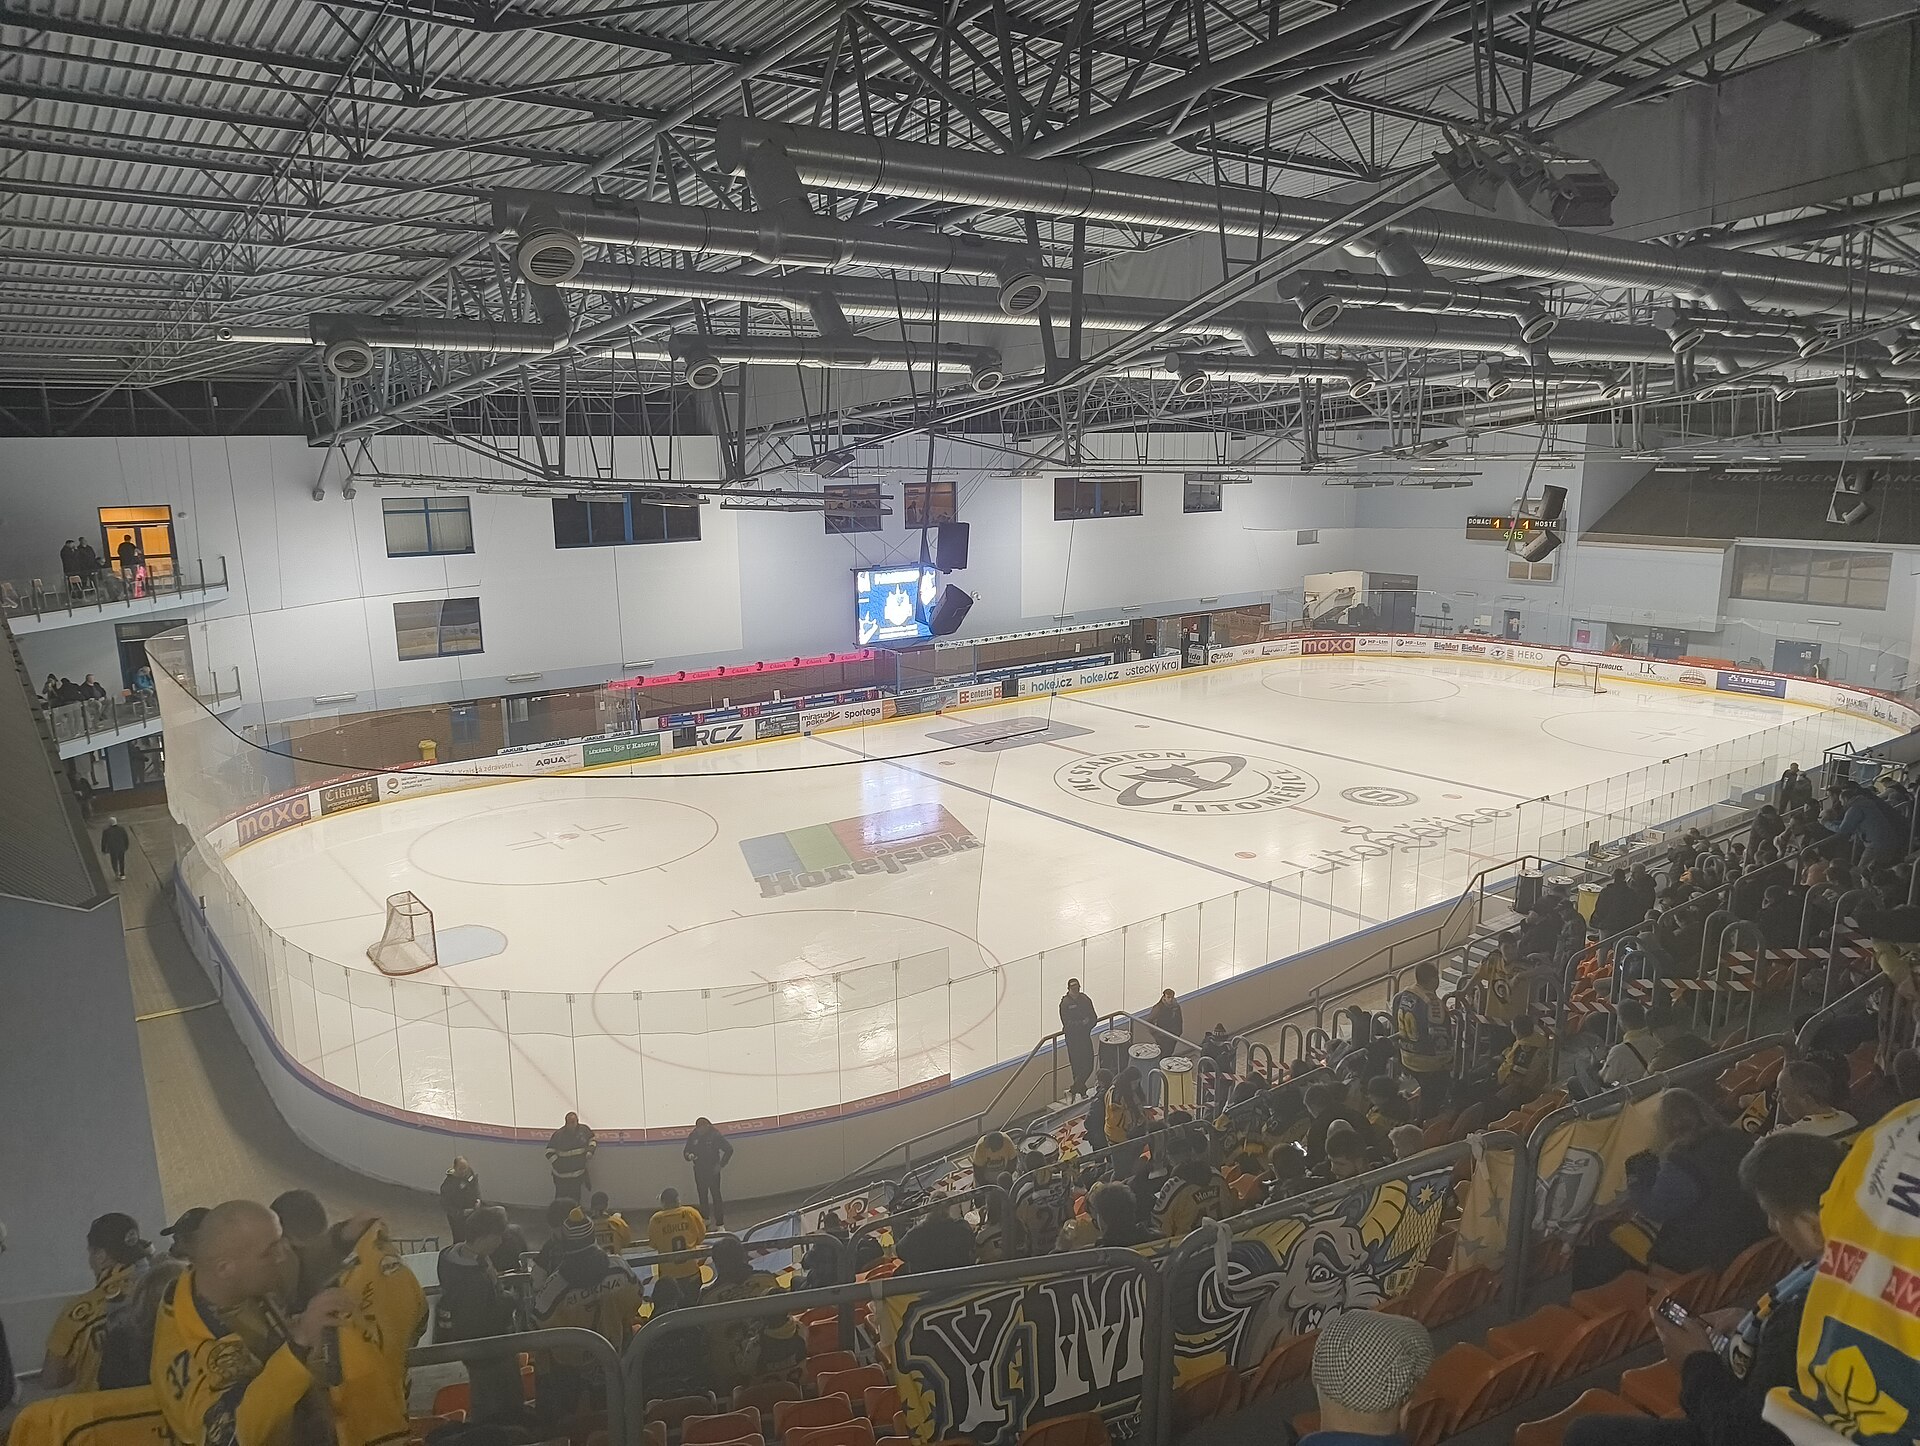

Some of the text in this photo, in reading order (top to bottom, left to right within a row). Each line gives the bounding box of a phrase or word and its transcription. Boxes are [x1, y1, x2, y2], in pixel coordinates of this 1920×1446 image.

[1493, 519, 1500, 529] 1
[1522, 520, 1529, 529] 1
[1302, 639, 1355, 652] maxa
[1517, 650, 1543, 661] HERO
[1161, 659, 1180, 672] kraj
[1640, 662, 1657, 675] LK
[1079, 670, 1119, 685] hokej.cz
[1739, 676, 1776, 687] TREMIS
[1031, 677, 1072, 693] hokej.cz
[970, 687, 993, 699] enteria
[801, 709, 835, 722] mirasushi
[844, 706, 881, 720] Sportega
[535, 756, 567, 767] AQUA
[1069, 751, 1187, 792] HC STADION
[325, 782, 373, 802] Cikánek
[238, 798, 310, 842] maxa
